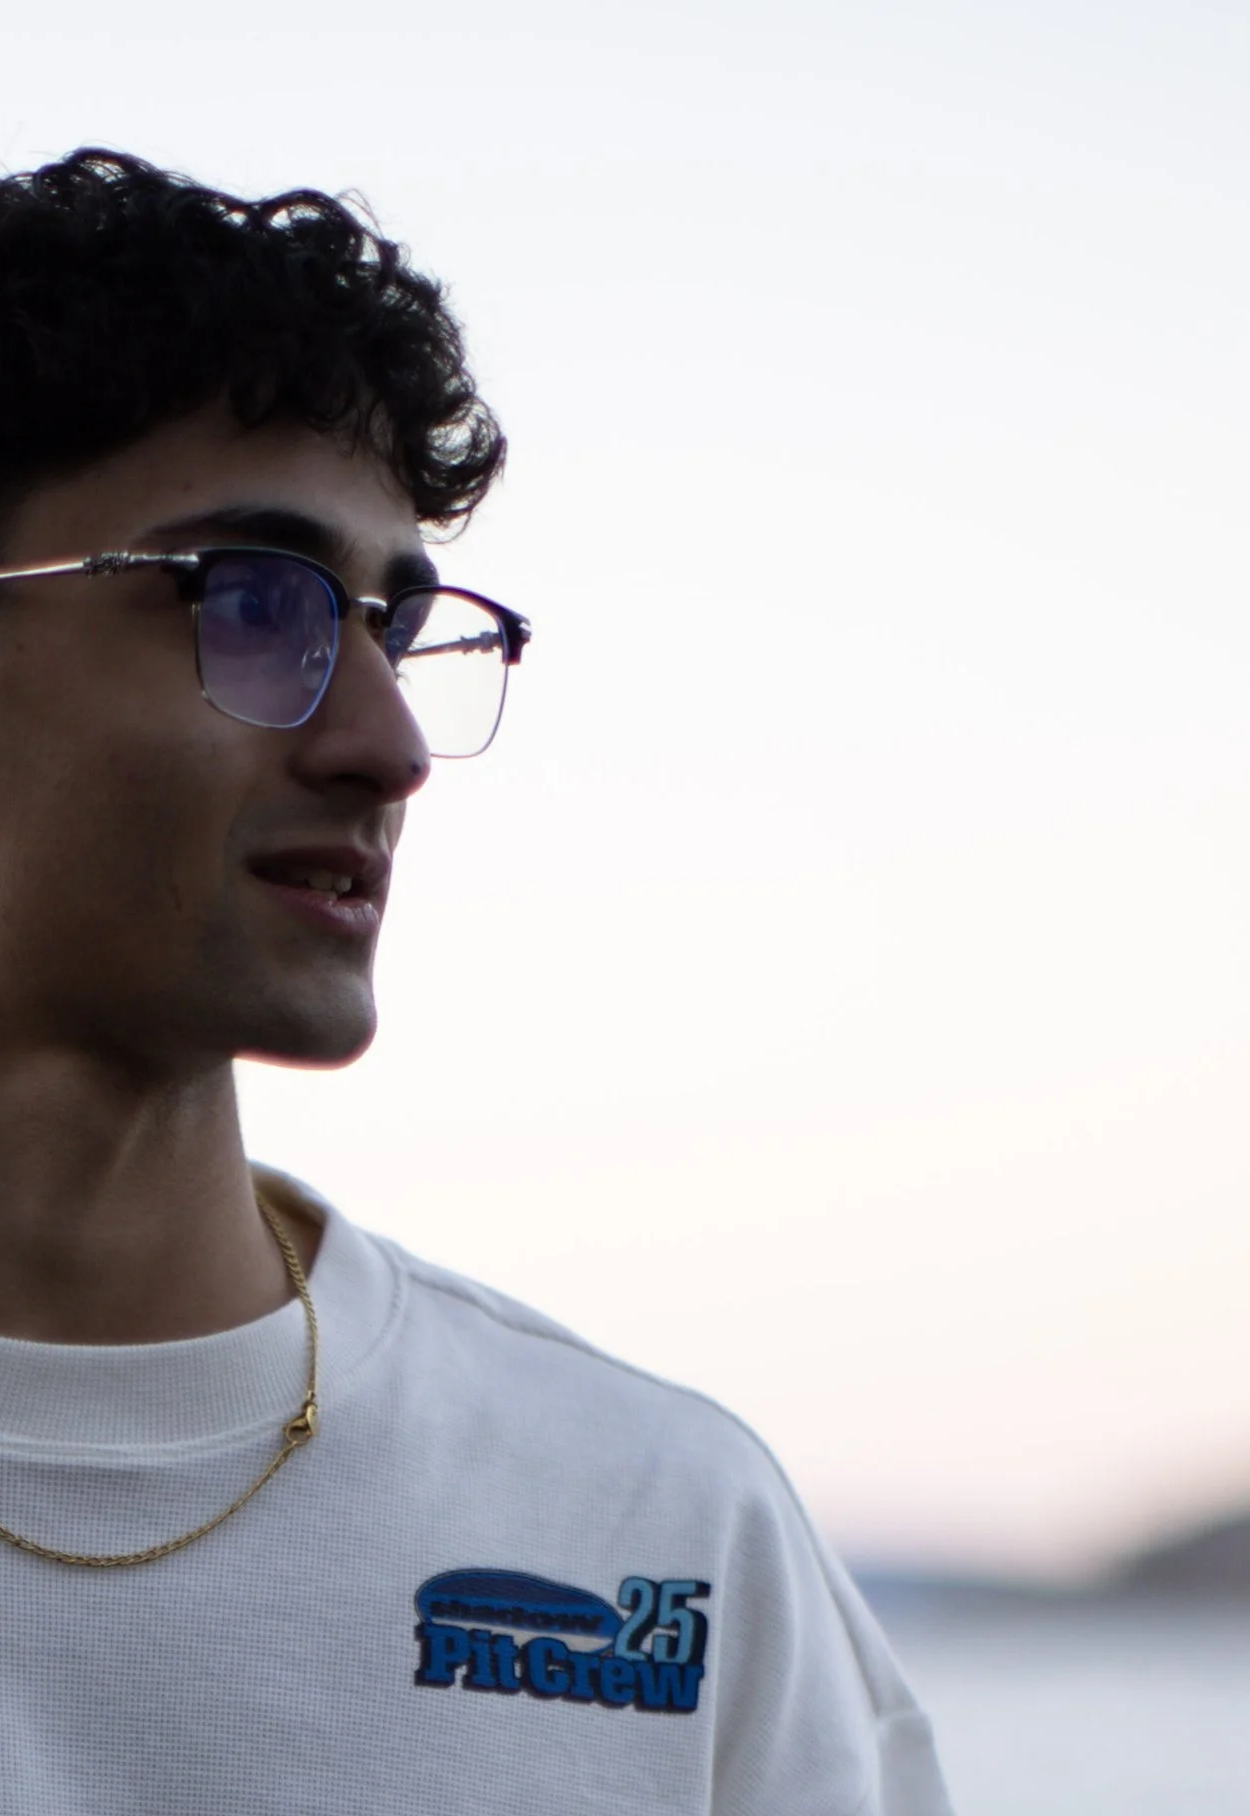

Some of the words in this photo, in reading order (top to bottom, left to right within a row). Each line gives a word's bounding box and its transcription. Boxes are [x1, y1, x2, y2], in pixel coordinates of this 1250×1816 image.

[613, 1575, 711, 1665] 25
[415, 1621, 523, 1694] Pit
[520, 1636, 705, 1714] Crew
